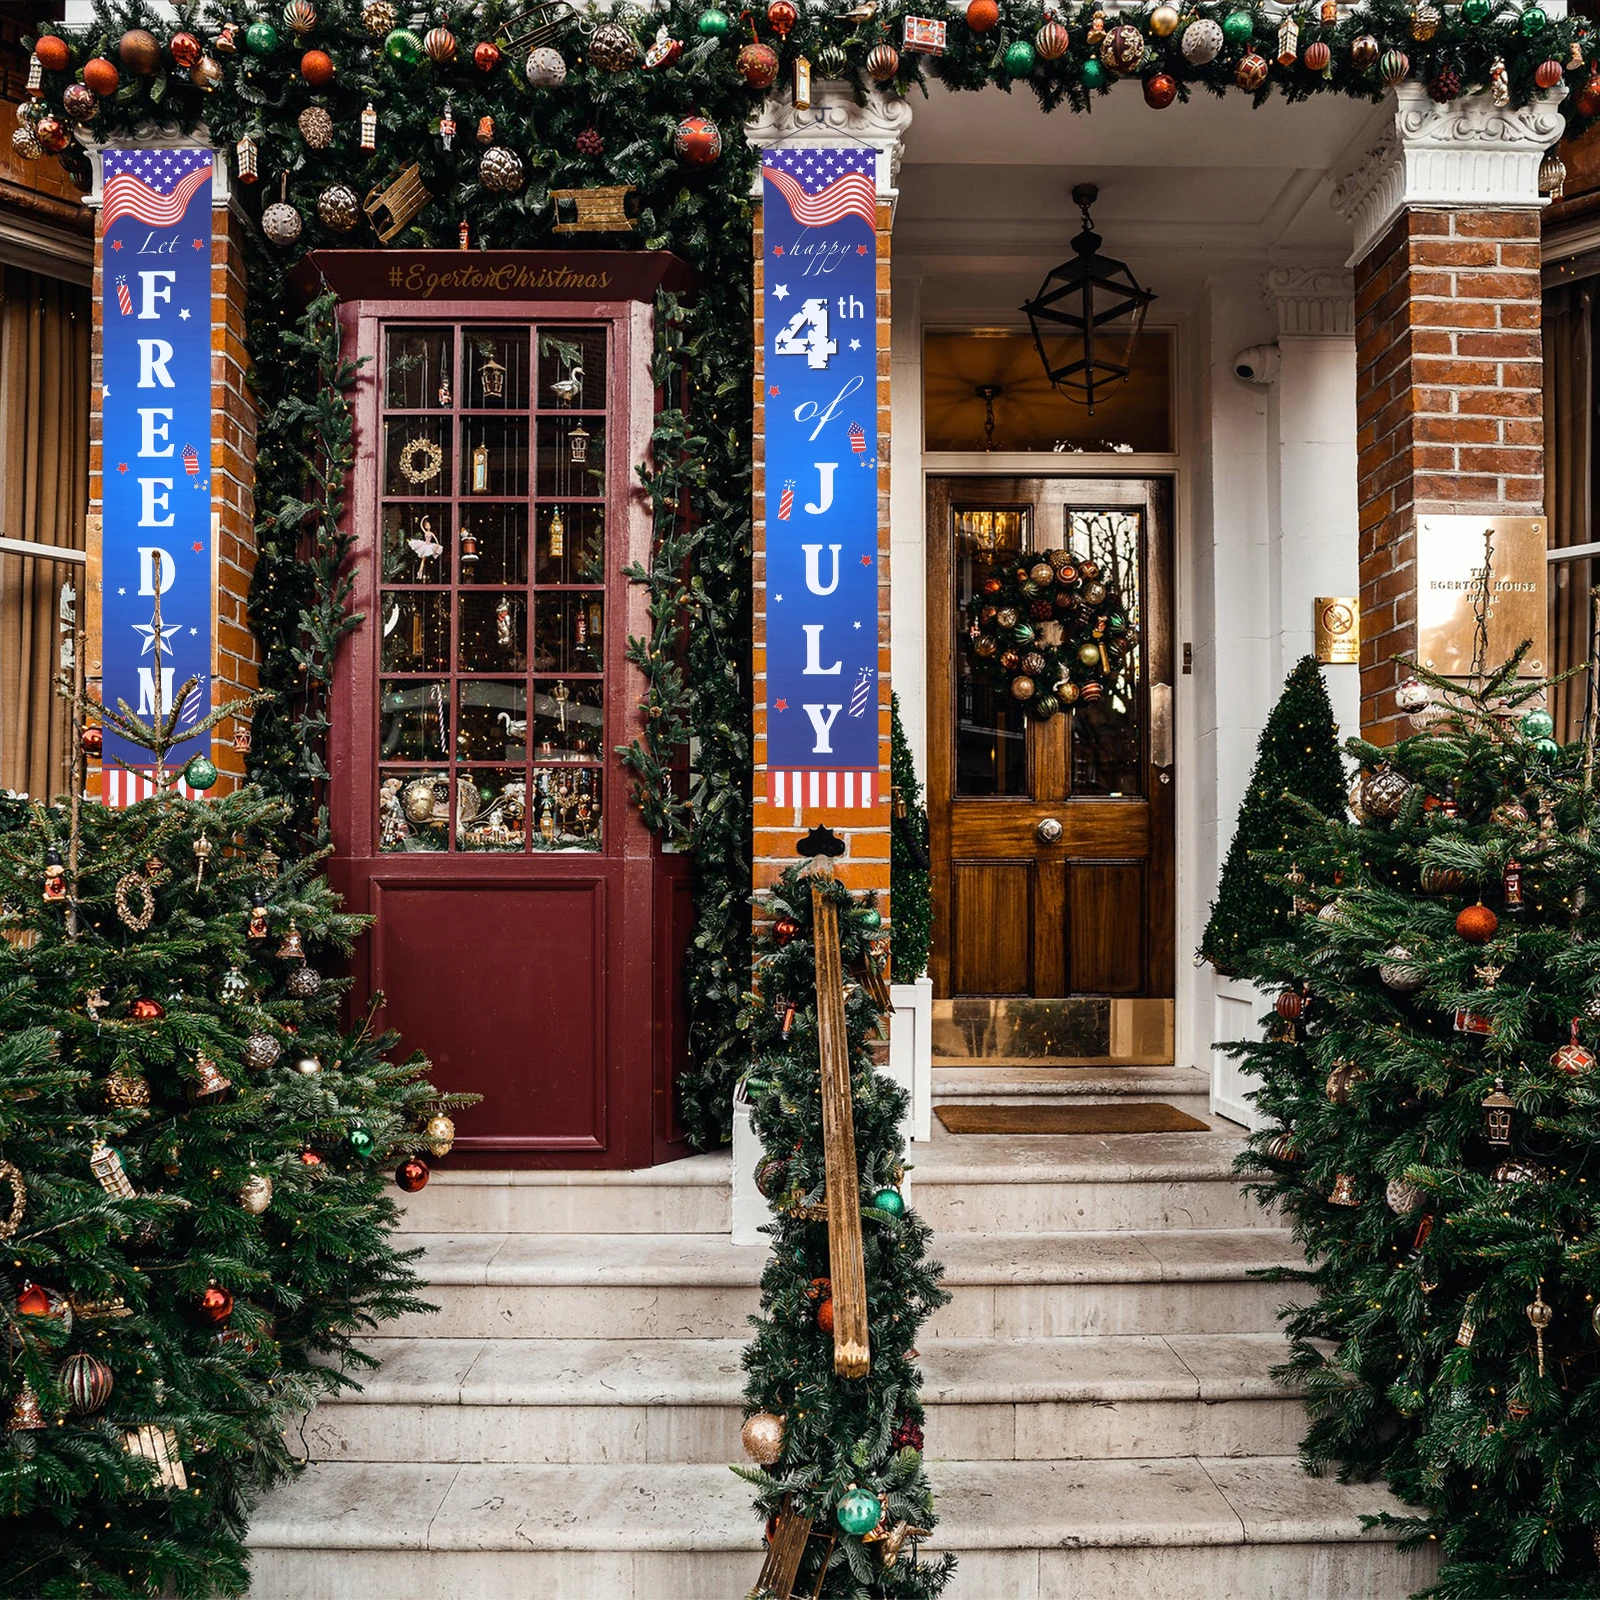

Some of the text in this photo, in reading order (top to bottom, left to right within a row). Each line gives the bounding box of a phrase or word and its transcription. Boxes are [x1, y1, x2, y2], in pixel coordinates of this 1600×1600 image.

[136, 230, 181, 255] Let
[789, 225, 851, 277] happy
[388, 263, 613, 299] #EgertonChristmas
[792, 375, 865, 442] of
[1466, 594, 1500, 603] HOEL
[1494, 581, 1537, 592] HOUSE
[801, 462, 843, 754] JULY
